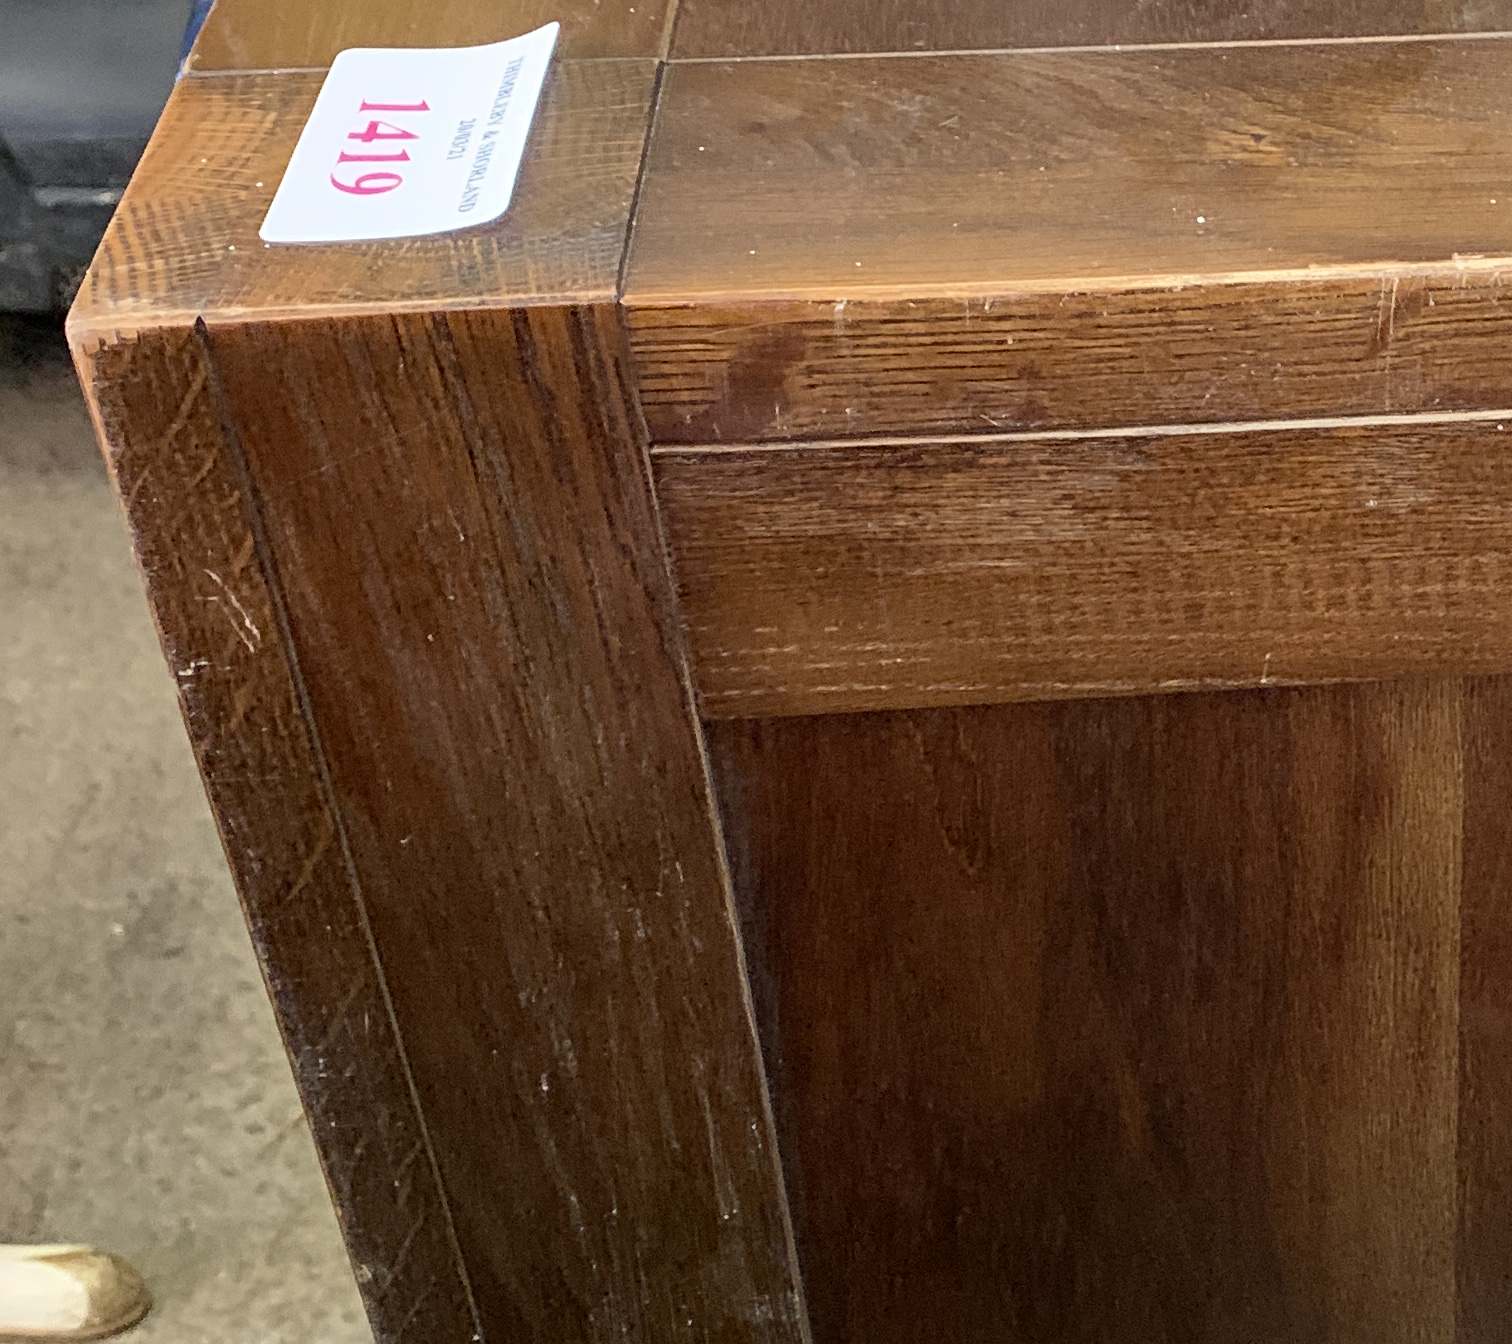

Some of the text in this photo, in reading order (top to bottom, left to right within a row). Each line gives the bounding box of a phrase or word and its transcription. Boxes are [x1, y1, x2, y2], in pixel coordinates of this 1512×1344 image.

[329, 98, 431, 196] 1419
[446, 118, 476, 161] 20/03/21
[457, 56, 525, 213] THIMBLEBY & SHORLAND
